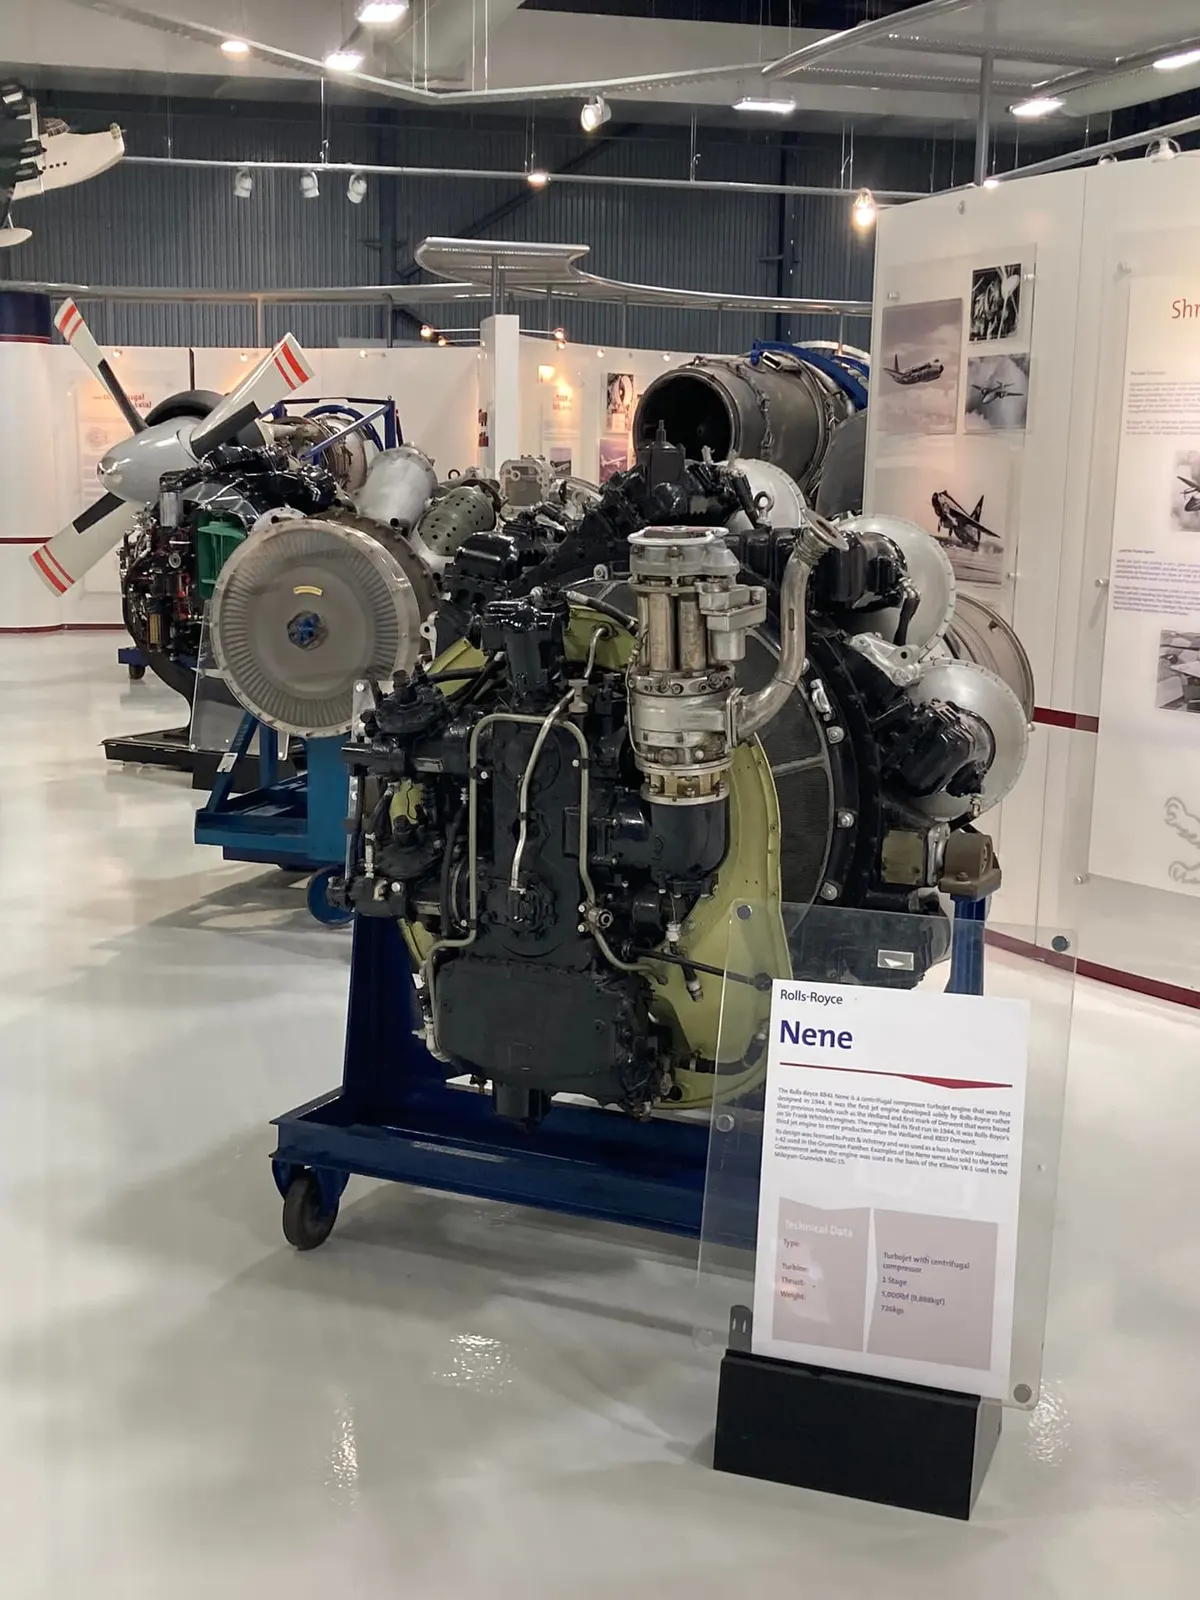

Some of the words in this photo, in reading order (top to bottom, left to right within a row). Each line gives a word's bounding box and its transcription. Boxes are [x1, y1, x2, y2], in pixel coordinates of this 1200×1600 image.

[780, 989, 843, 1006] Rolls-Royce
[780, 1020, 853, 1049] Nene
[778, 1095, 802, 1104] designed
[880, 1106, 900, 1114] engine
[902, 1108, 931, 1118] developed
[932, 1111, 949, 1120] solely
[959, 1114, 990, 1124] Rolls-Royce
[790, 1088, 818, 1098] Rolls-Royce
[861, 1096, 892, 1106] centrifugal
[893, 1100, 925, 1109] compressor
[926, 1103, 950, 1112] turbojet
[951, 1105, 971, 1114] engine
[791, 1104, 814, 1113] previous
[938, 1120, 963, 1128] Derwent
[869, 1120, 888, 1129] engine
[798, 1120, 818, 1129] engine
[841, 1125, 872, 1135] production
[775, 1143, 809, 1152] Government
[839, 1151, 857, 1160] engine
[783, 1129, 801, 1138] design
[862, 1138, 886, 1147] Whitney
[975, 1150, 1008, 1161] subsequent
[871, 1146, 897, 1156] Examples
[785, 1220, 828, 1233] Technical
[830, 1225, 853, 1237] Data
[883, 1264, 922, 1273] compressor
[884, 1252, 911, 1262] Turbojet
[931, 1259, 970, 1270] centrifugal
[888, 1277, 907, 1287] Stage
